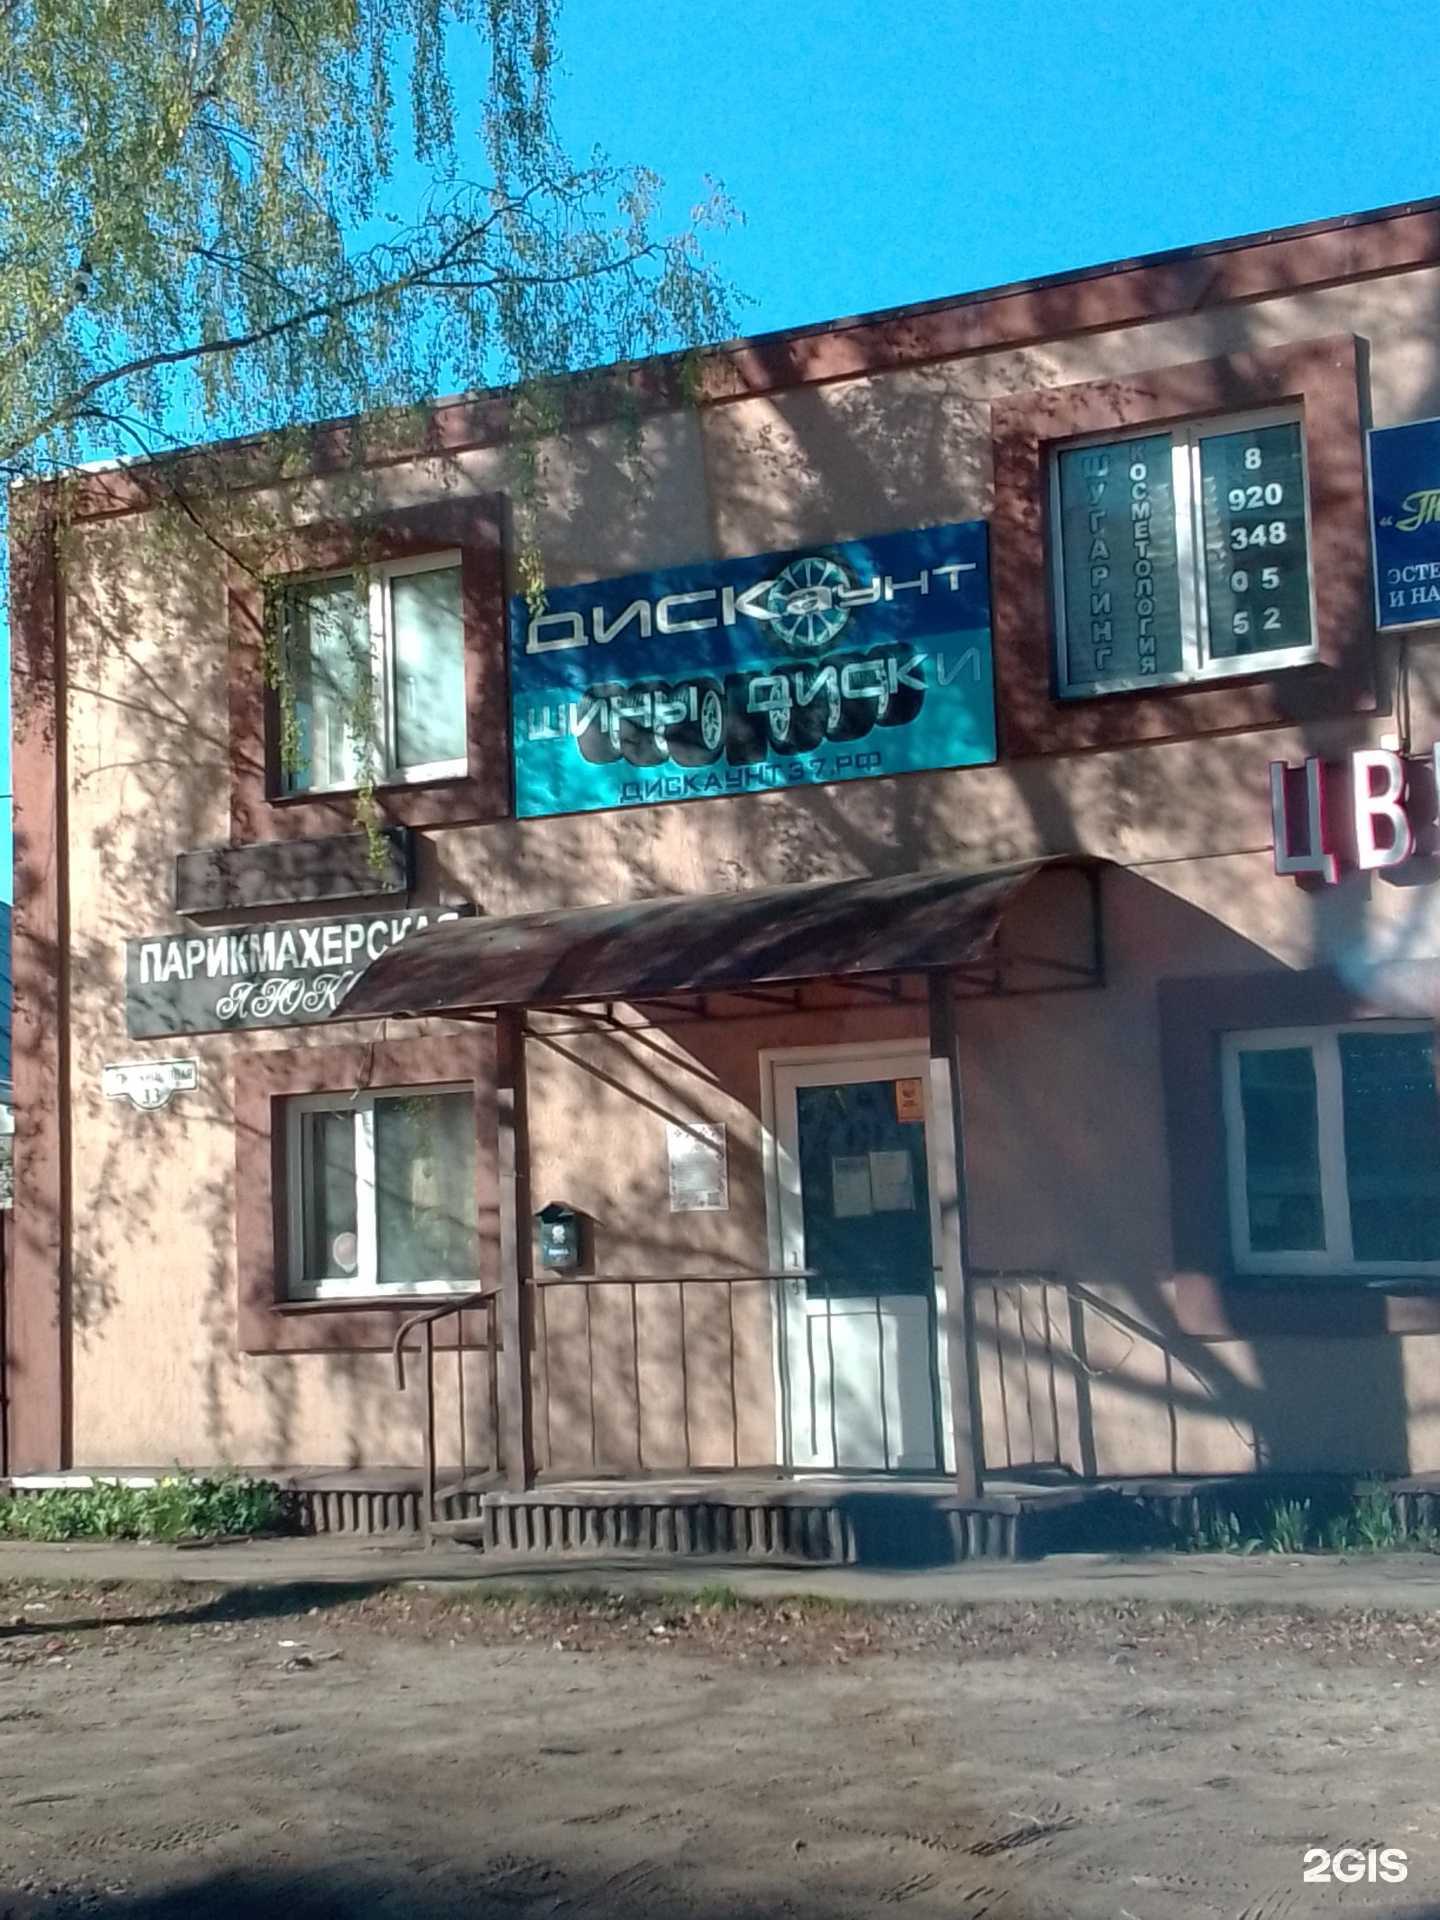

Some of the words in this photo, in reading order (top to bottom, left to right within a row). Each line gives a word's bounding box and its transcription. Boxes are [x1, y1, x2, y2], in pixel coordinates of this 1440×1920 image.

[1245, 448, 1262, 470] 8
[1228, 483, 1283, 512] 920
[1231, 521, 1287, 550] 348
[1389, 590, 1405, 608] И
[747, 647, 981, 713] ДИСКИ
[528, 686, 698, 741] ШИНЫ
[1271, 741, 1440, 884] ЦВ
[139, 912, 459, 984] ПАРИКМАХЕРСК
